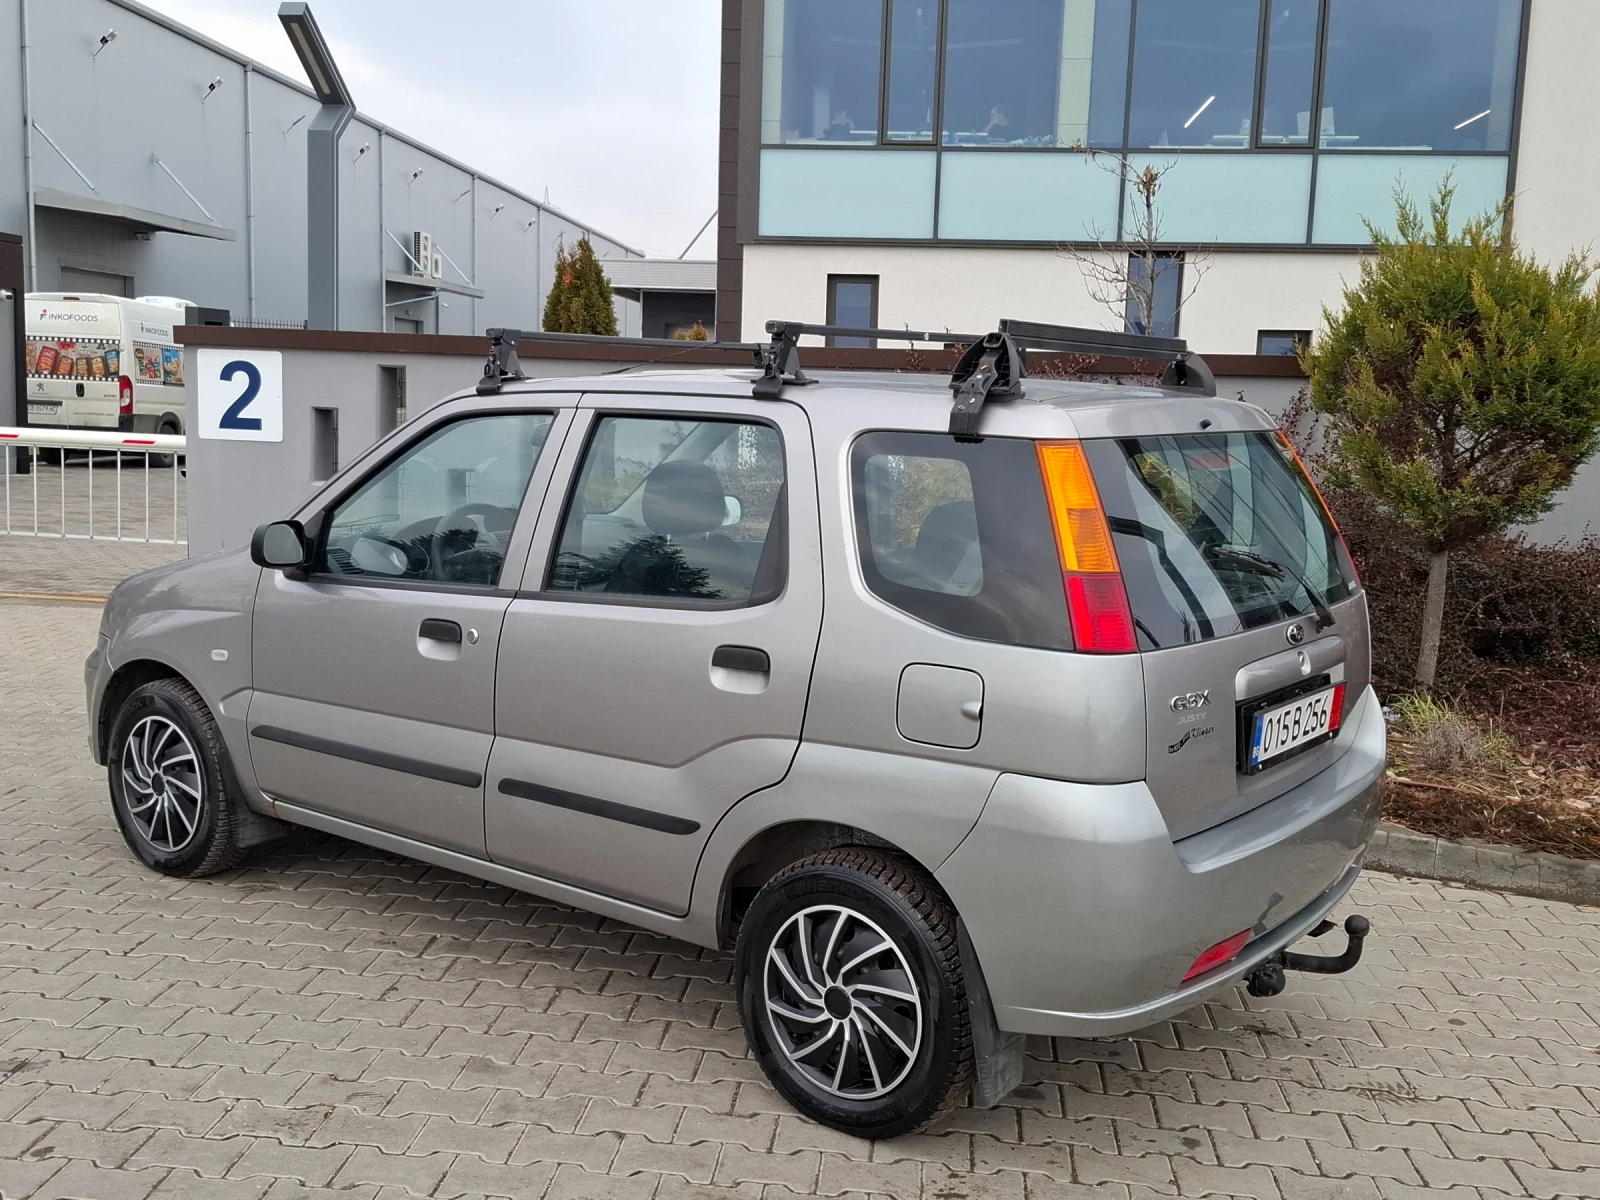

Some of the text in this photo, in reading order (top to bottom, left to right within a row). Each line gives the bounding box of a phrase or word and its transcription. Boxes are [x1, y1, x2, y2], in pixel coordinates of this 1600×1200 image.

[48, 313, 99, 322] INKOFOODS
[218, 360, 262, 431] 2
[1177, 711, 1207, 725] JUSTY
